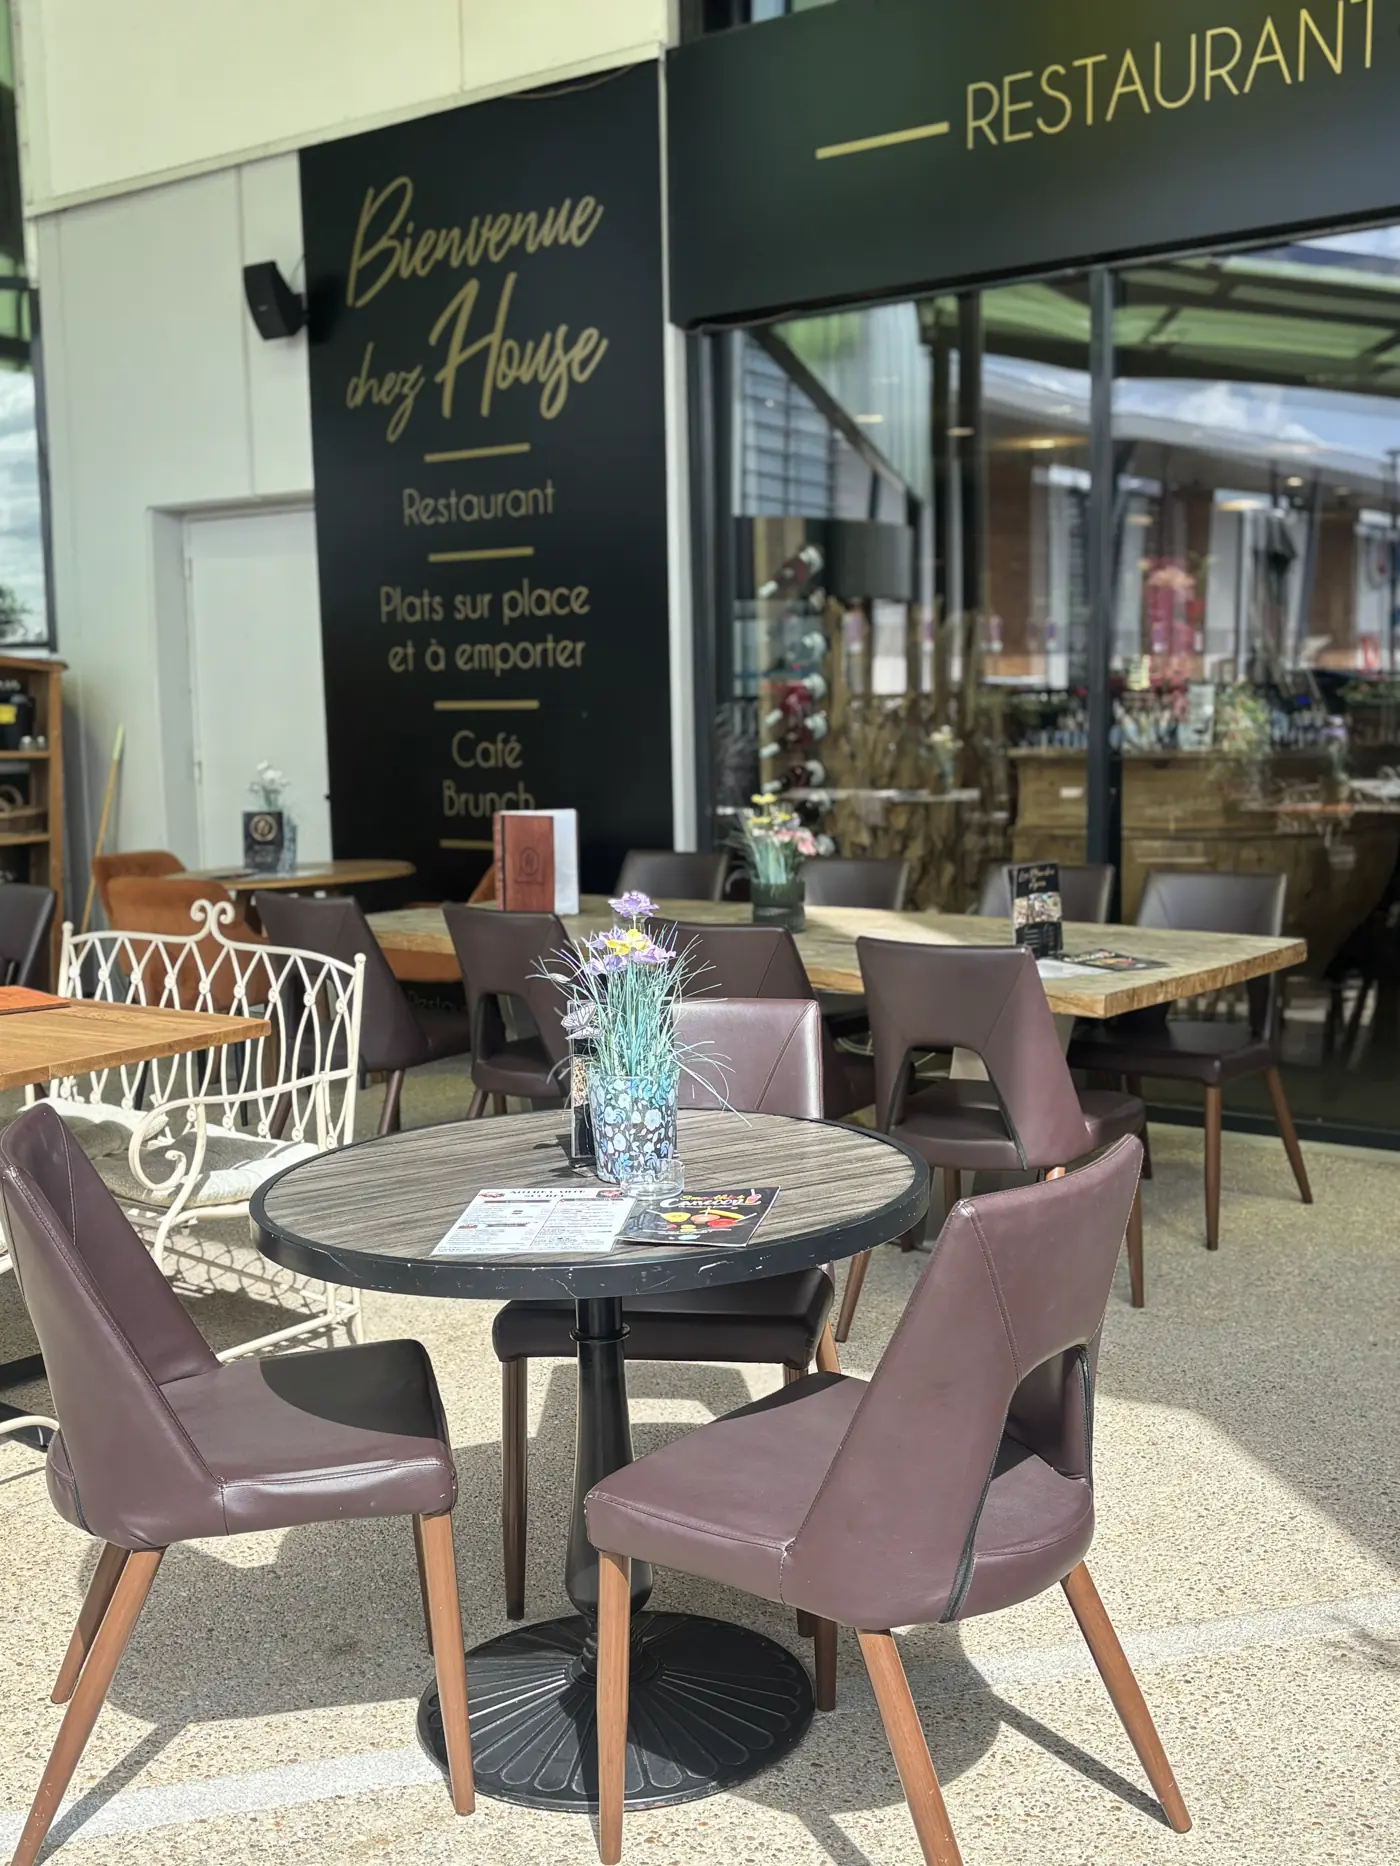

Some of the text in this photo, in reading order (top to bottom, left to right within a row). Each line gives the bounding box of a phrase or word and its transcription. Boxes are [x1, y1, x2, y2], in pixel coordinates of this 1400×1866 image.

[967, 0, 1374, 149] RESTAURANT
[346, 175, 604, 308] Bienvenue
[346, 271, 609, 443] chez House
[402, 479, 555, 526] Restaurant
[380, 578, 591, 625] Plats sur place
[388, 633, 586, 677] et à emporter
[451, 729, 523, 769] Café
[442, 779, 536, 818] Brunch
